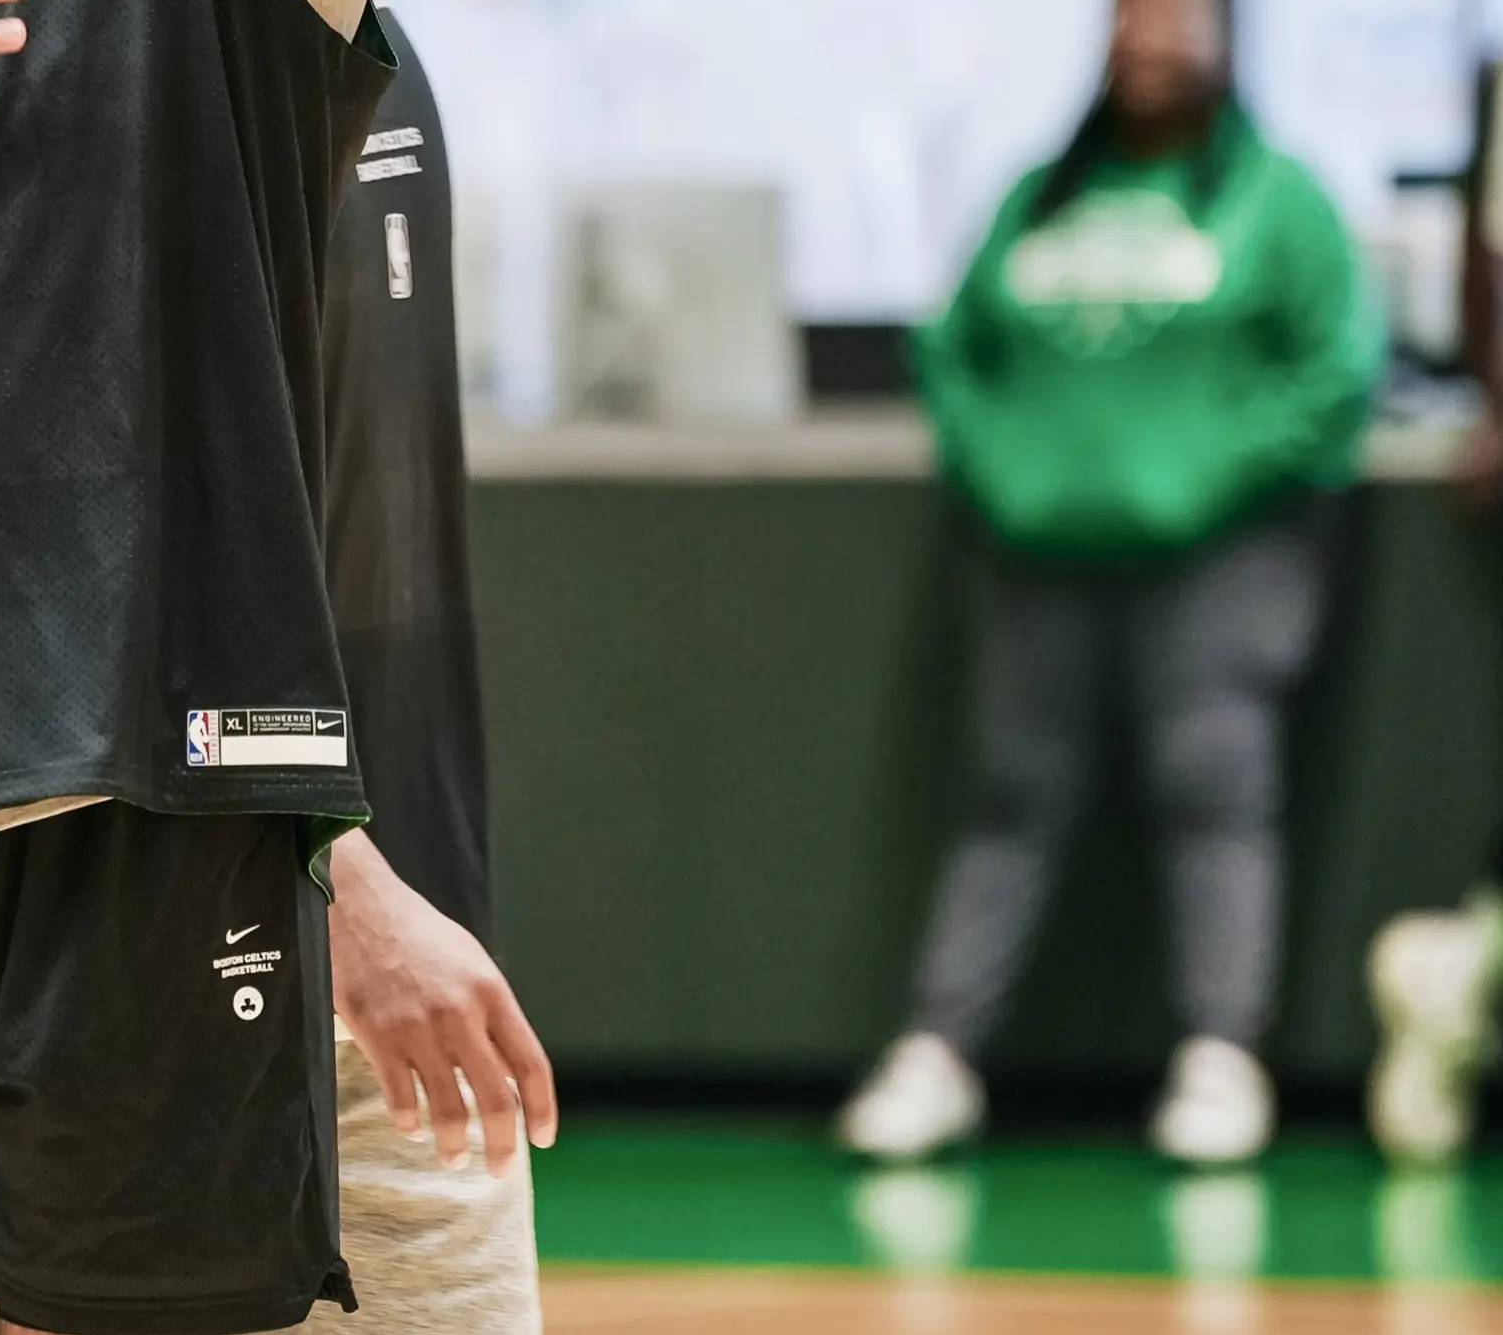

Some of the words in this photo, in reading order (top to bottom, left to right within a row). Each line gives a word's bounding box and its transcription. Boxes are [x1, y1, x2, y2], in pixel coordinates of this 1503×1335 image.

[225, 717, 244, 731] XL
[213, 955, 243, 969] BOSTON
[244, 950, 281, 962] CELTICS
[221, 962, 274, 979] BASKETBALL
